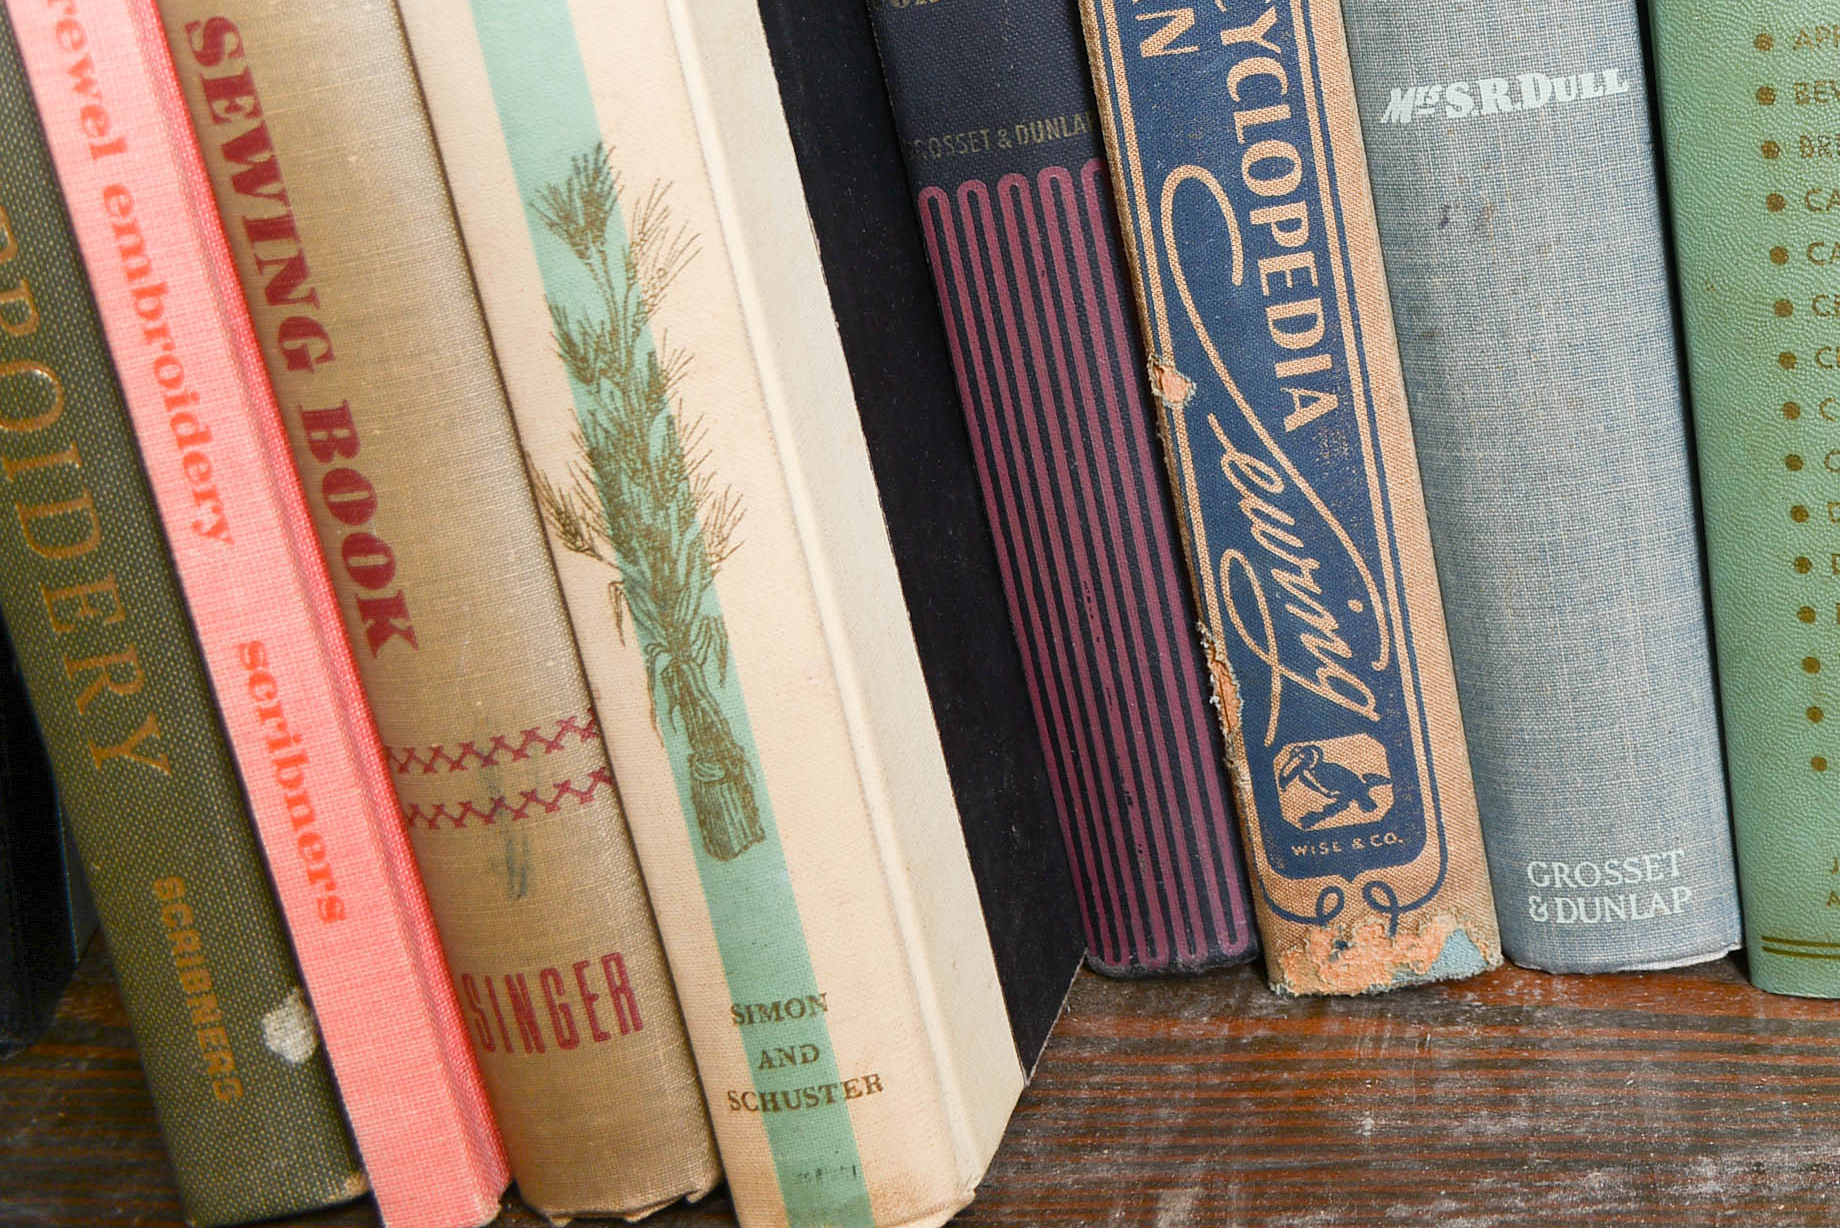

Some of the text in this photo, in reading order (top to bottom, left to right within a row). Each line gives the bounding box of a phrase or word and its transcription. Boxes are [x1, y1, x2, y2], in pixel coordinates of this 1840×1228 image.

[998, 128, 1013, 149] &
[185, 15, 419, 659] SEWING BOOK
[103, 183, 235, 546] embroidery
[1161, 164, 1391, 747] Sewing
[238, 640, 346, 924] scribners
[1291, 832, 1404, 856] WISE & CO.
[1527, 849, 1685, 888] GROSSET
[462, 952, 644, 1054] SINGER
[730, 991, 829, 1027] SIMON
[758, 1042, 820, 1070] AND
[727, 1073, 884, 1112] SCHUSTER
